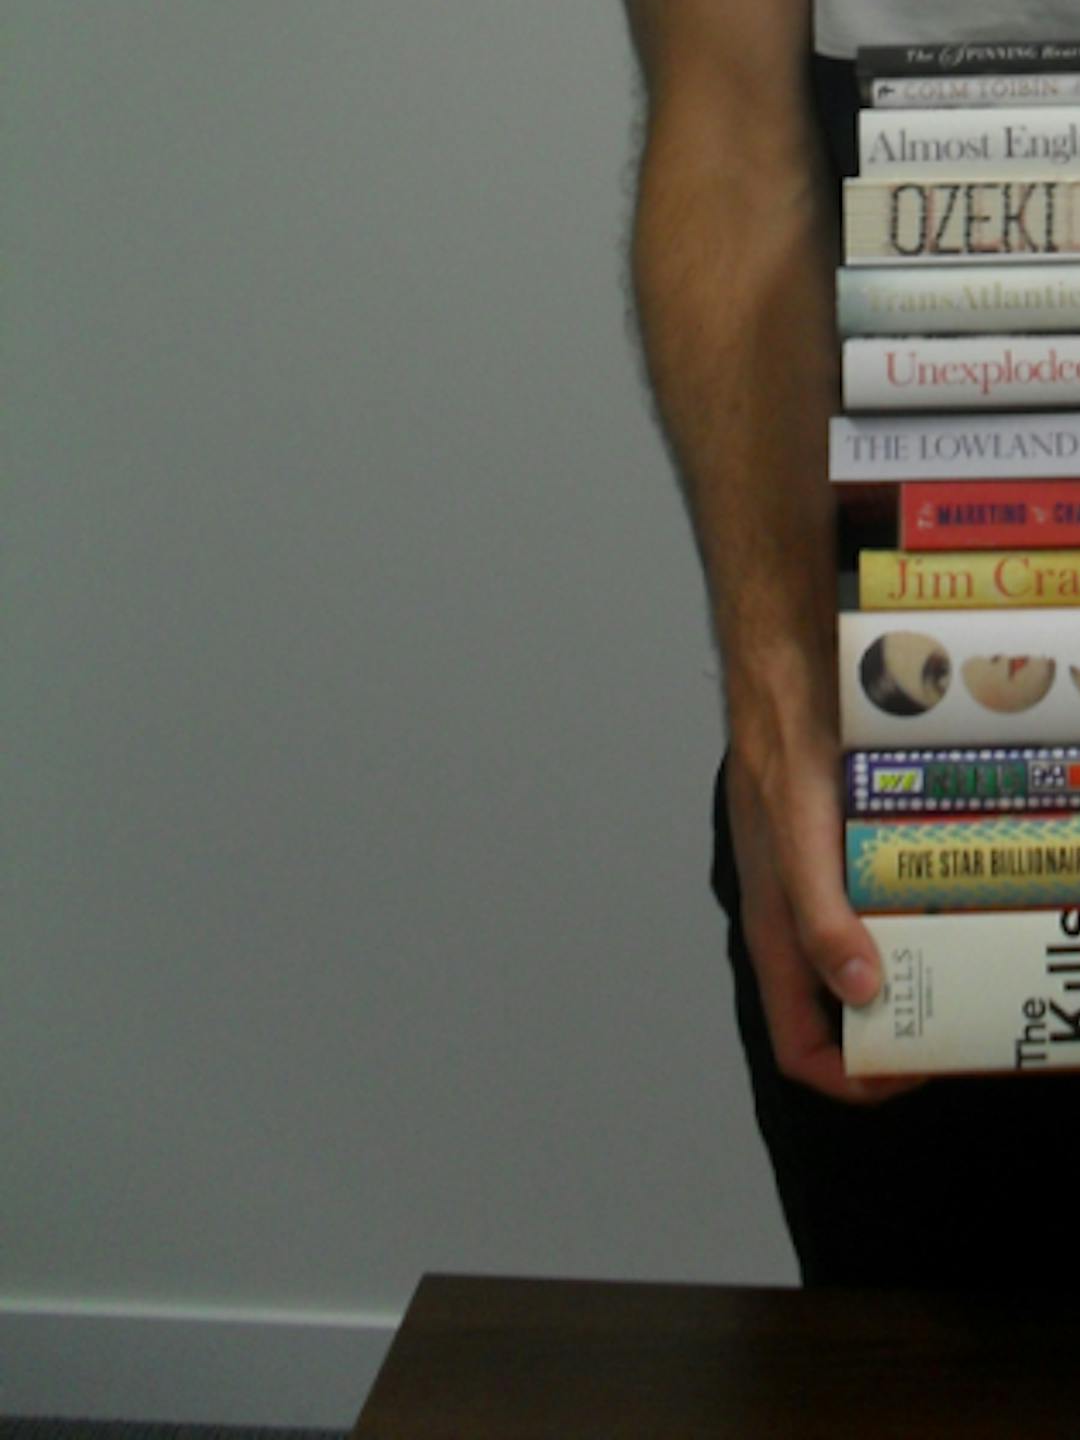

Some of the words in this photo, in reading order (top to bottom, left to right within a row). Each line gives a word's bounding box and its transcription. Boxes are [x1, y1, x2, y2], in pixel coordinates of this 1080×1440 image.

[869, 128, 990, 163] Almost
[889, 182, 1059, 256] OZEKI
[848, 436, 910, 461] THE
[920, 432, 1078, 460] LOWLAND
[887, 557, 975, 602] Jim
[897, 851, 935, 882] FIVE
[939, 848, 985, 880] STAR
[894, 950, 913, 1038] KILLS
[1014, 997, 1048, 1070] The
